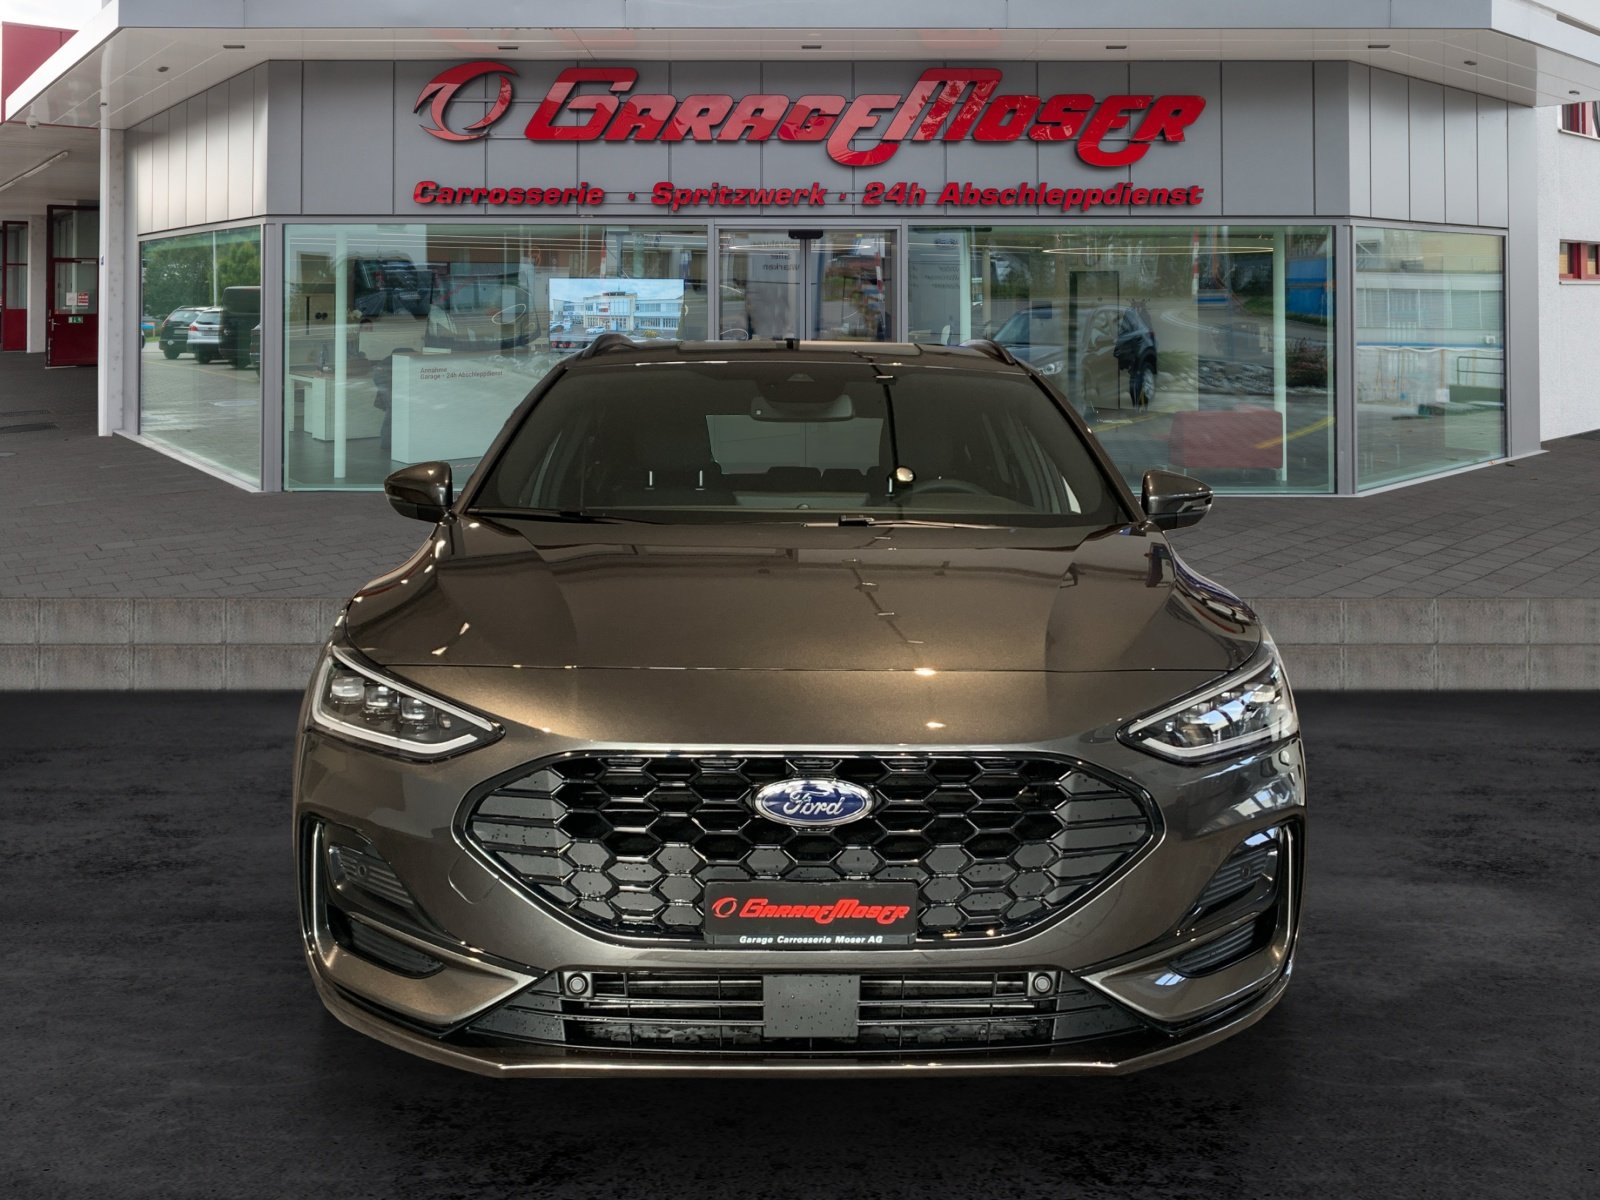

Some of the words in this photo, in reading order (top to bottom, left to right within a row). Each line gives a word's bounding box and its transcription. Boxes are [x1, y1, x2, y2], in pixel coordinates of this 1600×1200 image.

[413, 180, 605, 206] Carrosserie
[651, 181, 826, 212] Spritzwerk
[863, 181, 926, 206] 24h
[937, 181, 1205, 212] Abschleppdienst
[783, 790, 844, 817] Ford
[739, 935, 774, 945] Garage
[777, 935, 832, 944] Carrosserie
[835, 935, 866, 944] Moser
[867, 935, 884, 944] AG
